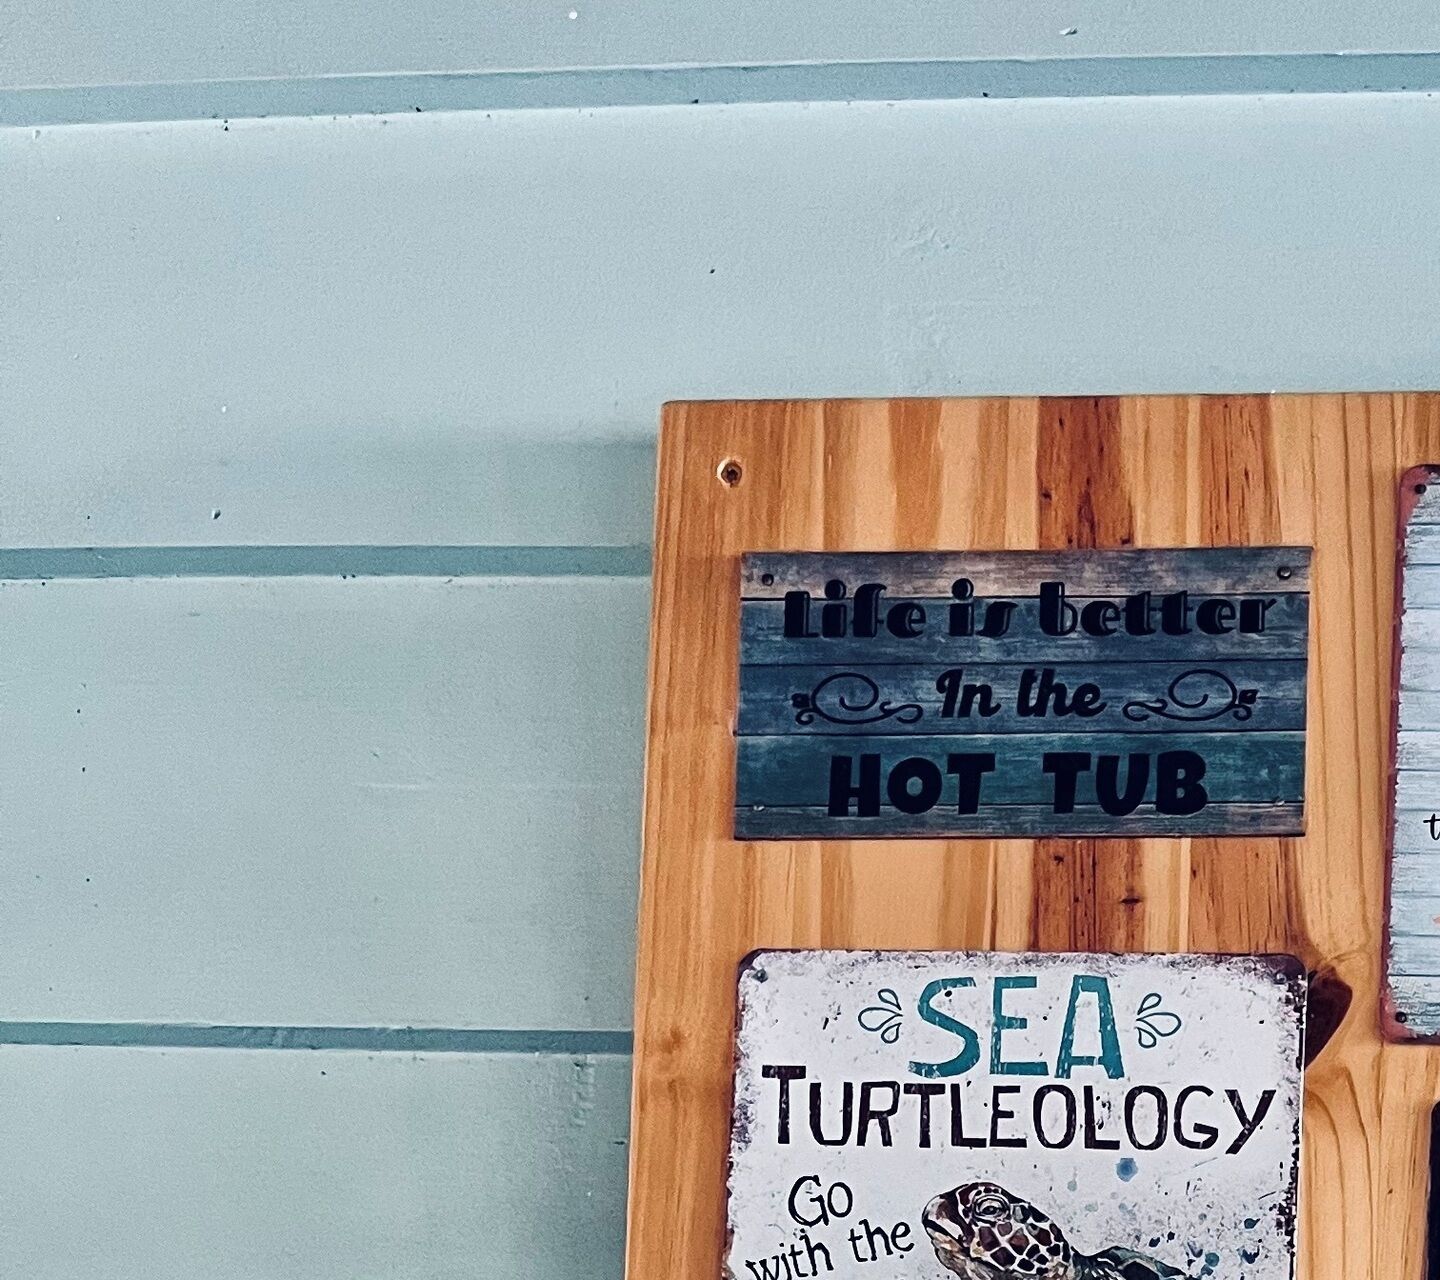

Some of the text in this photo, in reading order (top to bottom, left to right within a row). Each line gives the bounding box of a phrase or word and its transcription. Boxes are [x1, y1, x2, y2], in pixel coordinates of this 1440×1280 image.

[783, 577, 1277, 638] Life is better
[936, 668, 1106, 719] In the
[828, 750, 1208, 817] HOT TUB
[908, 975, 1125, 1079] SEA
[762, 1064, 1276, 1155] TURTLEOLOGY
[788, 1174, 853, 1227] Go
[848, 1219, 914, 1263] the
